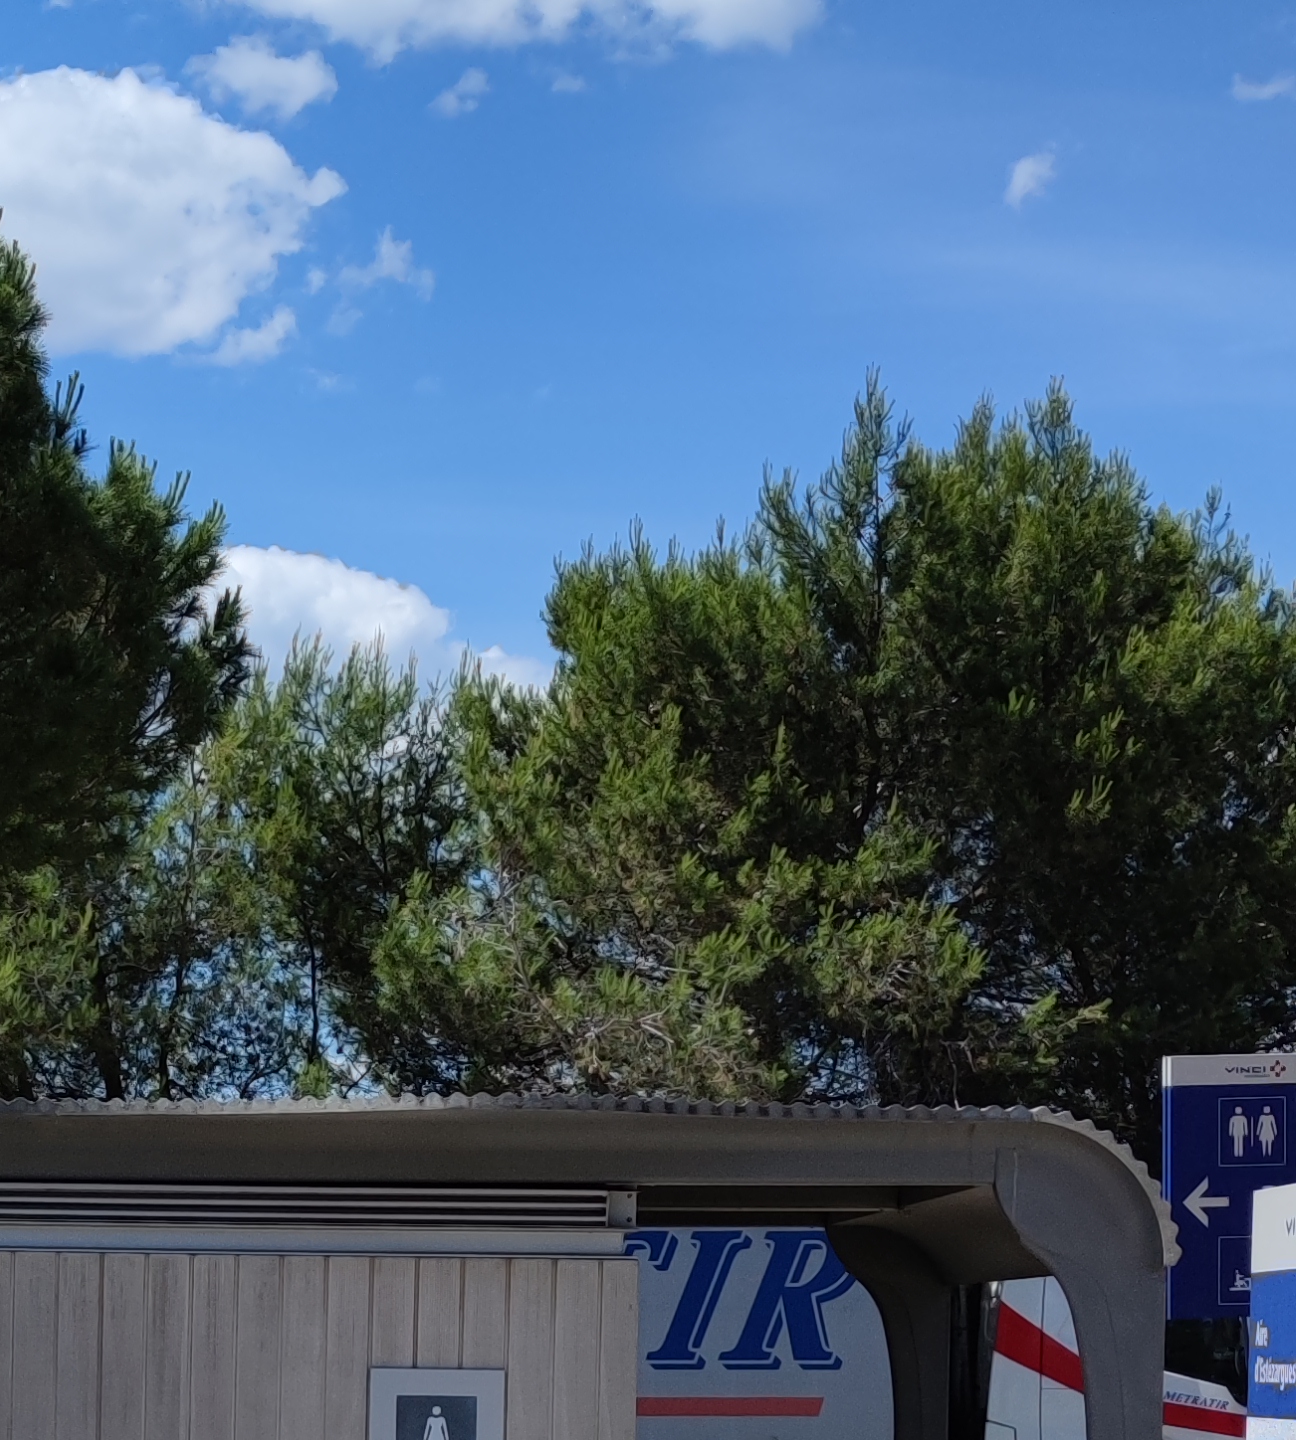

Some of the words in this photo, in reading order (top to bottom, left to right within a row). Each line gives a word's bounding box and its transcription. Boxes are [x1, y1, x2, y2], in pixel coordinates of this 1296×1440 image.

[1225, 1066, 1266, 1074] VINCI
[1254, 1319, 1268, 1347] Aire
[1164, 1391, 1229, 1410] METRATIR
